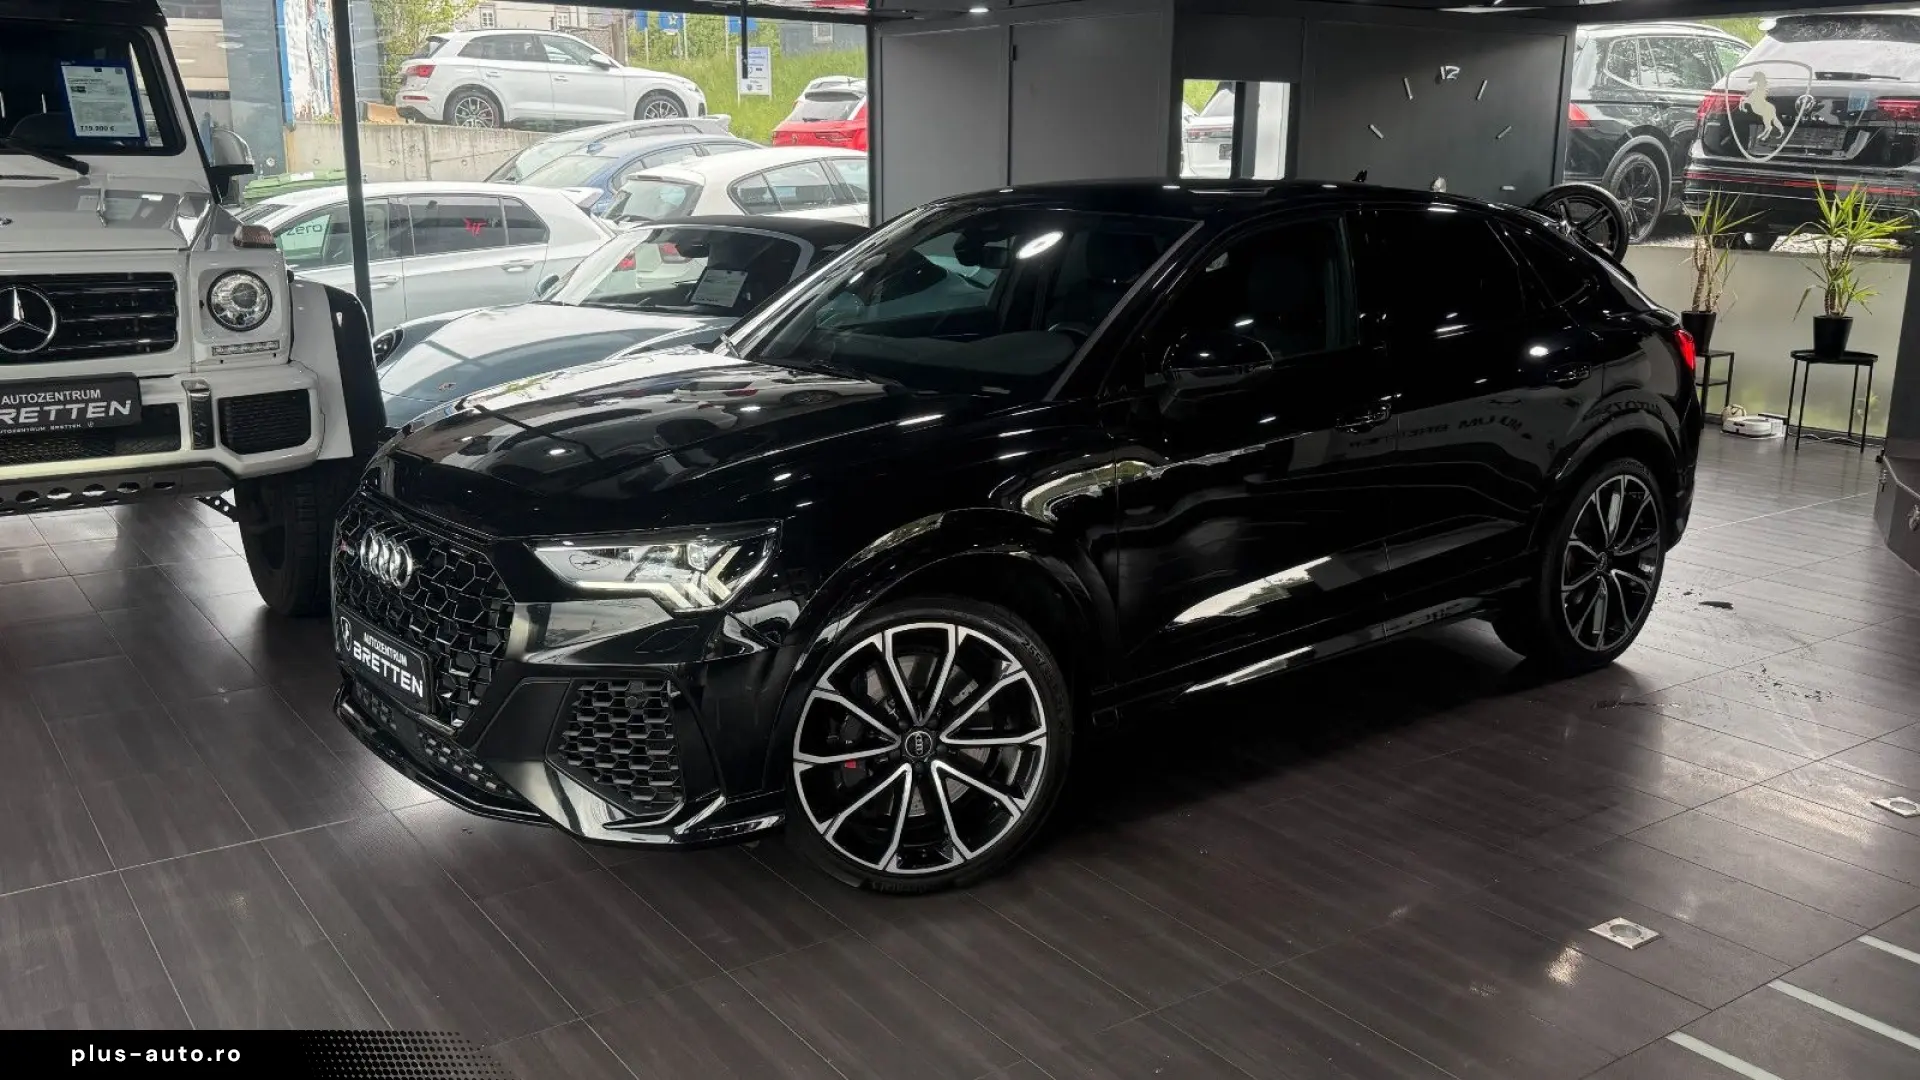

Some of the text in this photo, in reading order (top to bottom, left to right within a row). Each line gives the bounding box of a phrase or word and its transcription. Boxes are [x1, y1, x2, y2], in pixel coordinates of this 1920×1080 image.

[1440, 66, 1460, 80] 12
[1, 389, 101, 404] AUTOZENTRUM
[364, 632, 408, 667] AUTOZENTRUM
[353, 640, 423, 697] BRETTEN
